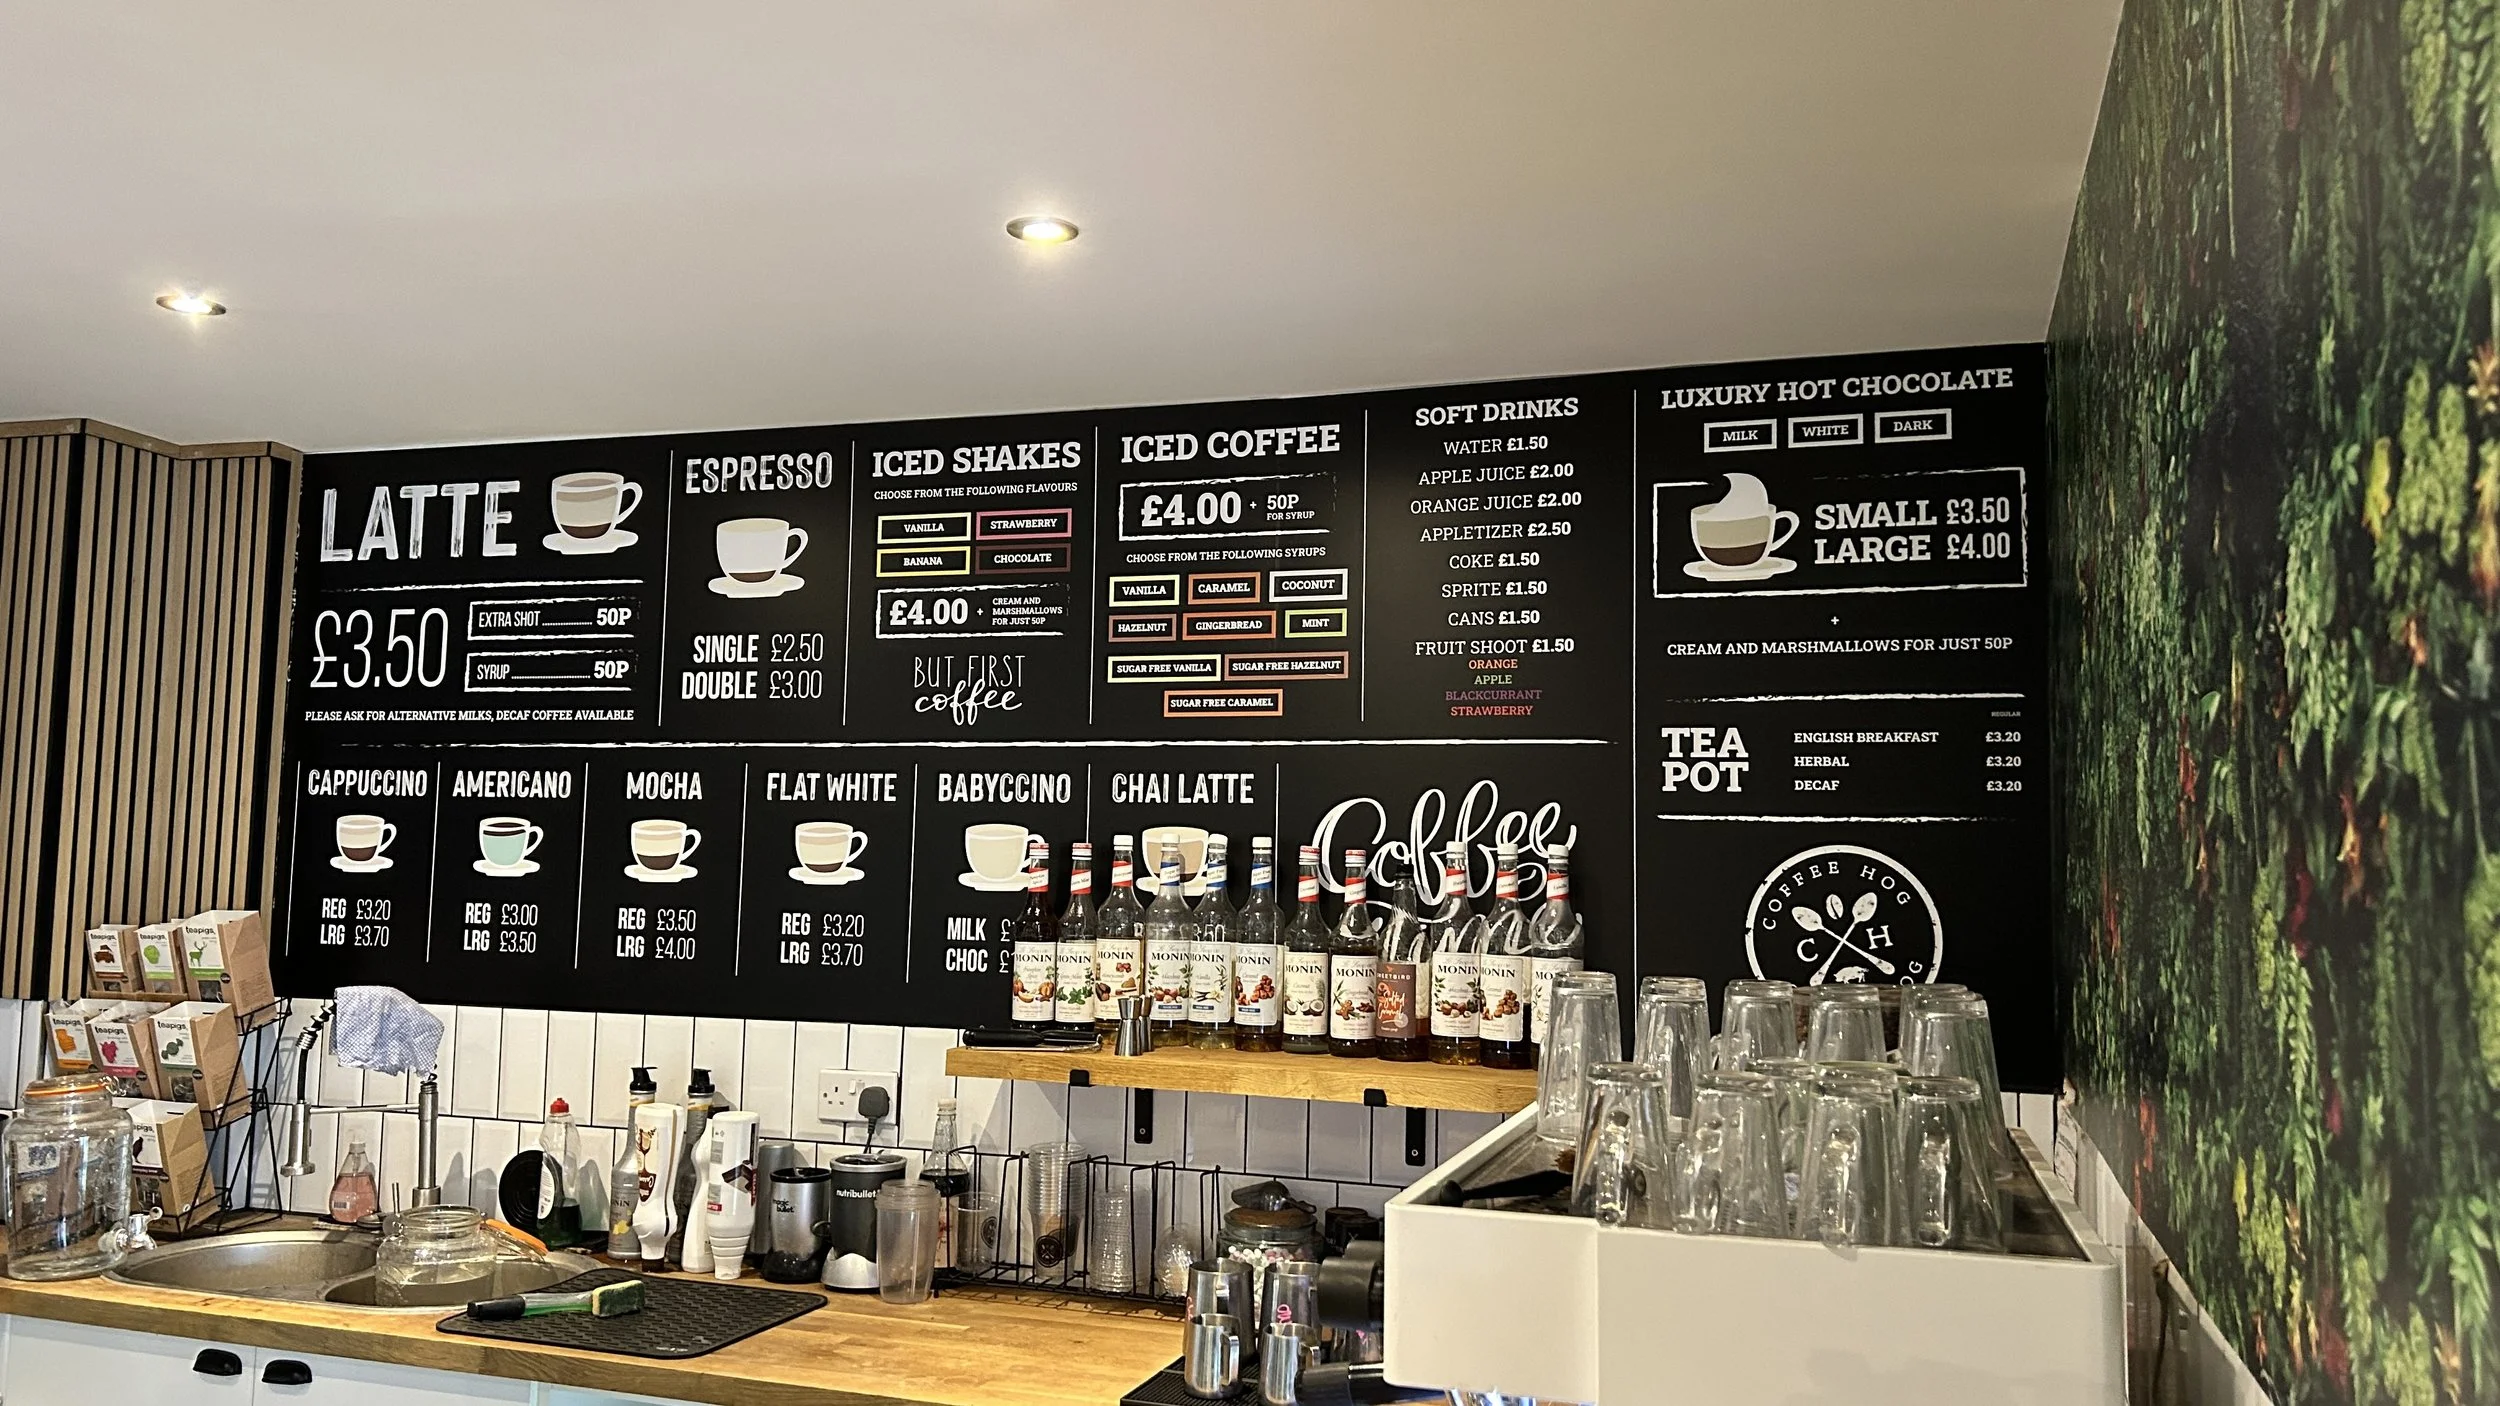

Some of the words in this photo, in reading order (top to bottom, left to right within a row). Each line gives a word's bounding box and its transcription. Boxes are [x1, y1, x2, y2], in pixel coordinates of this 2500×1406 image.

[1661, 383, 1771, 409] LUXURY
[1777, 379, 1836, 402] HOT
[1843, 368, 2013, 397] CHOCOLATE
[1415, 404, 1478, 426] SOFT
[1483, 397, 1578, 422] DRINKS
[1802, 425, 1849, 437] WHITE
[1893, 420, 1933, 432] DARK
[1121, 434, 1198, 463] ICED
[1207, 424, 1340, 459] COFFEE
[1723, 430, 1758, 442] MILK
[1443, 439, 1502, 455] WATER
[1507, 436, 1548, 451] £1.50
[872, 449, 944, 477] ICED
[953, 441, 1081, 473] SHAKES
[686, 452, 832, 494] ESPRESSO
[1418, 469, 1472, 485] APPLE
[1476, 466, 1525, 482] JUICE
[1530, 463, 1574, 479] £2.00
[874, 490, 912, 500] CHOOSE
[914, 488, 942, 498] FROM
[944, 487, 964, 497] THE
[966, 484, 1024, 496] FOLLOWING
[1026, 482, 1078, 493] FLAVOURS
[1141, 491, 1241, 527] £4.00
[1267, 494, 1299, 510] 50P
[1410, 497, 1479, 514] ORANGE
[1483, 494, 1533, 510] JUICE
[1537, 492, 1582, 507] £2.00
[320, 480, 520, 562] LATTE
[1267, 512, 1284, 521] FOR
[1285, 511, 1315, 520] SYRUP
[1815, 500, 1937, 530] SMALL
[1946, 497, 2010, 524] £3.50
[904, 523, 944, 533] VANILLA
[990, 518, 1058, 529] STRAWBERRY
[1420, 524, 1523, 542] APPLETIZER
[1527, 521, 1571, 537] £2.50
[1126, 553, 1166, 563] CHOOSE
[1168, 552, 1197, 562] FROM
[1199, 551, 1220, 560] THE
[1222, 549, 1283, 560] FOLLOWING
[1284, 547, 1326, 557] SYRUPS
[1814, 535, 1931, 564] LARGE
[1947, 532, 2010, 559] £4.00
[903, 556, 943, 566] BANANA
[994, 553, 1052, 563] CHOCOLATE
[1449, 554, 1494, 569] COKE
[1498, 552, 1540, 567] £1.50
[1122, 585, 1167, 595] VANILLA
[1198, 582, 1250, 593] CARAMEL
[1282, 579, 1335, 590] COCONUT
[1442, 582, 1501, 598] SPRITE
[1505, 581, 1547, 595] £1.50
[992, 597, 1022, 605] CREAM
[1023, 597, 1041, 605] AND
[596, 608, 632, 626] 50P
[890, 598, 968, 625] £4.00
[992, 606, 1063, 615] MARSHMALLOWS
[1448, 611, 1494, 626] CANS
[1498, 610, 1540, 624] £1.50
[479, 611, 512, 628] EXTRA
[514, 611, 541, 627] SHOT
[1009, 617, 1031, 625] JUST
[1031, 617, 1046, 625] 50P
[1118, 623, 1167, 632] HAZELNUT
[1196, 620, 1263, 630] GINGERBREAD
[1302, 618, 1330, 628] MINT
[310, 608, 448, 688] £3.50
[693, 634, 759, 663] SINGLE
[770, 633, 823, 662] £2.50
[1415, 641, 1466, 655] FRUIT
[1470, 639, 1528, 654] SHOOT
[1532, 638, 1574, 653] £1.50
[1667, 643, 1722, 656] CREAM
[1725, 642, 1758, 655] AND
[1762, 639, 1900, 654] MARSHMALLOWS
[1904, 639, 1935, 651] FOR
[1938, 638, 1981, 650] JUST
[1985, 637, 2013, 649] 50P
[477, 664, 510, 680] SYRUP
[594, 660, 629, 679] 50P
[914, 656, 955, 688] BUT
[967, 654, 1026, 688] FIRST
[1117, 665, 1147, 673] SUGAR
[1148, 664, 1171, 673] FREE
[1173, 663, 1212, 672] VANILLA
[1232, 662, 1264, 671] SUGAR
[1265, 662, 1289, 670] FREE
[1290, 660, 1341, 670] HAZELNUT
[1469, 659, 1518, 669] ORANGE
[682, 671, 758, 699] DOUBLE
[769, 670, 822, 698] £3.00
[1474, 675, 1512, 685] APPLE
[914, 678, 1023, 726] coffee
[1170, 699, 1201, 708] SUGAR
[1202, 698, 1226, 707] FREE
[1227, 698, 1274, 707] CARAMEL
[1445, 690, 1542, 701] BLACKCURRANT
[305, 711, 342, 721] PLEASE
[343, 711, 365, 721] ASK
[365, 711, 386, 721] FOR
[387, 710, 456, 721] ALTERNATIVE
[458, 710, 494, 722] MILKS,
[496, 710, 531, 720] DECAF
[532, 710, 573, 720] COFFEE
[574, 710, 634, 720] AVAILABLE
[1451, 705, 1533, 716] STRAWBERRY
[1661, 727, 1749, 758] TEA
[1794, 732, 1854, 743] ENGLISH
[1856, 732, 1939, 743] BREAKFAST
[1985, 731, 2021, 742] £3.20
[1794, 756, 1850, 767] HERBAL
[1986, 756, 2021, 767] £3.20
[308, 769, 427, 797] CAPPUCCINO
[452, 770, 571, 798] AMERICANO
[1662, 761, 1749, 792] POT
[1794, 780, 1840, 790] DECAF
[626, 772, 702, 800] MOCHA
[767, 772, 820, 801] FLAT
[827, 773, 897, 802] WHITE
[938, 773, 1071, 803] BABYCCINO
[1112, 773, 1169, 803] CHAI
[1178, 773, 1254, 804] LATTE
[1986, 781, 2022, 791] £3.20
[1311, 779, 1577, 906] Coffee
[1762, 861, 1840, 931] COFFEE
[1859, 864, 1911, 906] HOG
[322, 898, 347, 919] REG
[356, 899, 391, 920] £3.20
[465, 902, 491, 924] REG
[501, 903, 538, 926] £3.00
[618, 908, 646, 930] REG
[656, 908, 696, 932] £3.50
[781, 913, 811, 935] REG
[822, 914, 864, 937] £3.20
[320, 924, 345, 945] LRG
[354, 925, 389, 947] £3.70
[947, 917, 987, 941] MILK
[463, 929, 490, 951] LRG
[499, 931, 536, 953] £3.50
[616, 935, 645, 958] LRG
[655, 936, 695, 960] £4.00
[946, 948, 988, 972] CHOC
[1336, 968, 1375, 978] MONIN
[1438, 965, 1478, 975] MONIN
[836, 1189, 877, 1199] nutribullet
